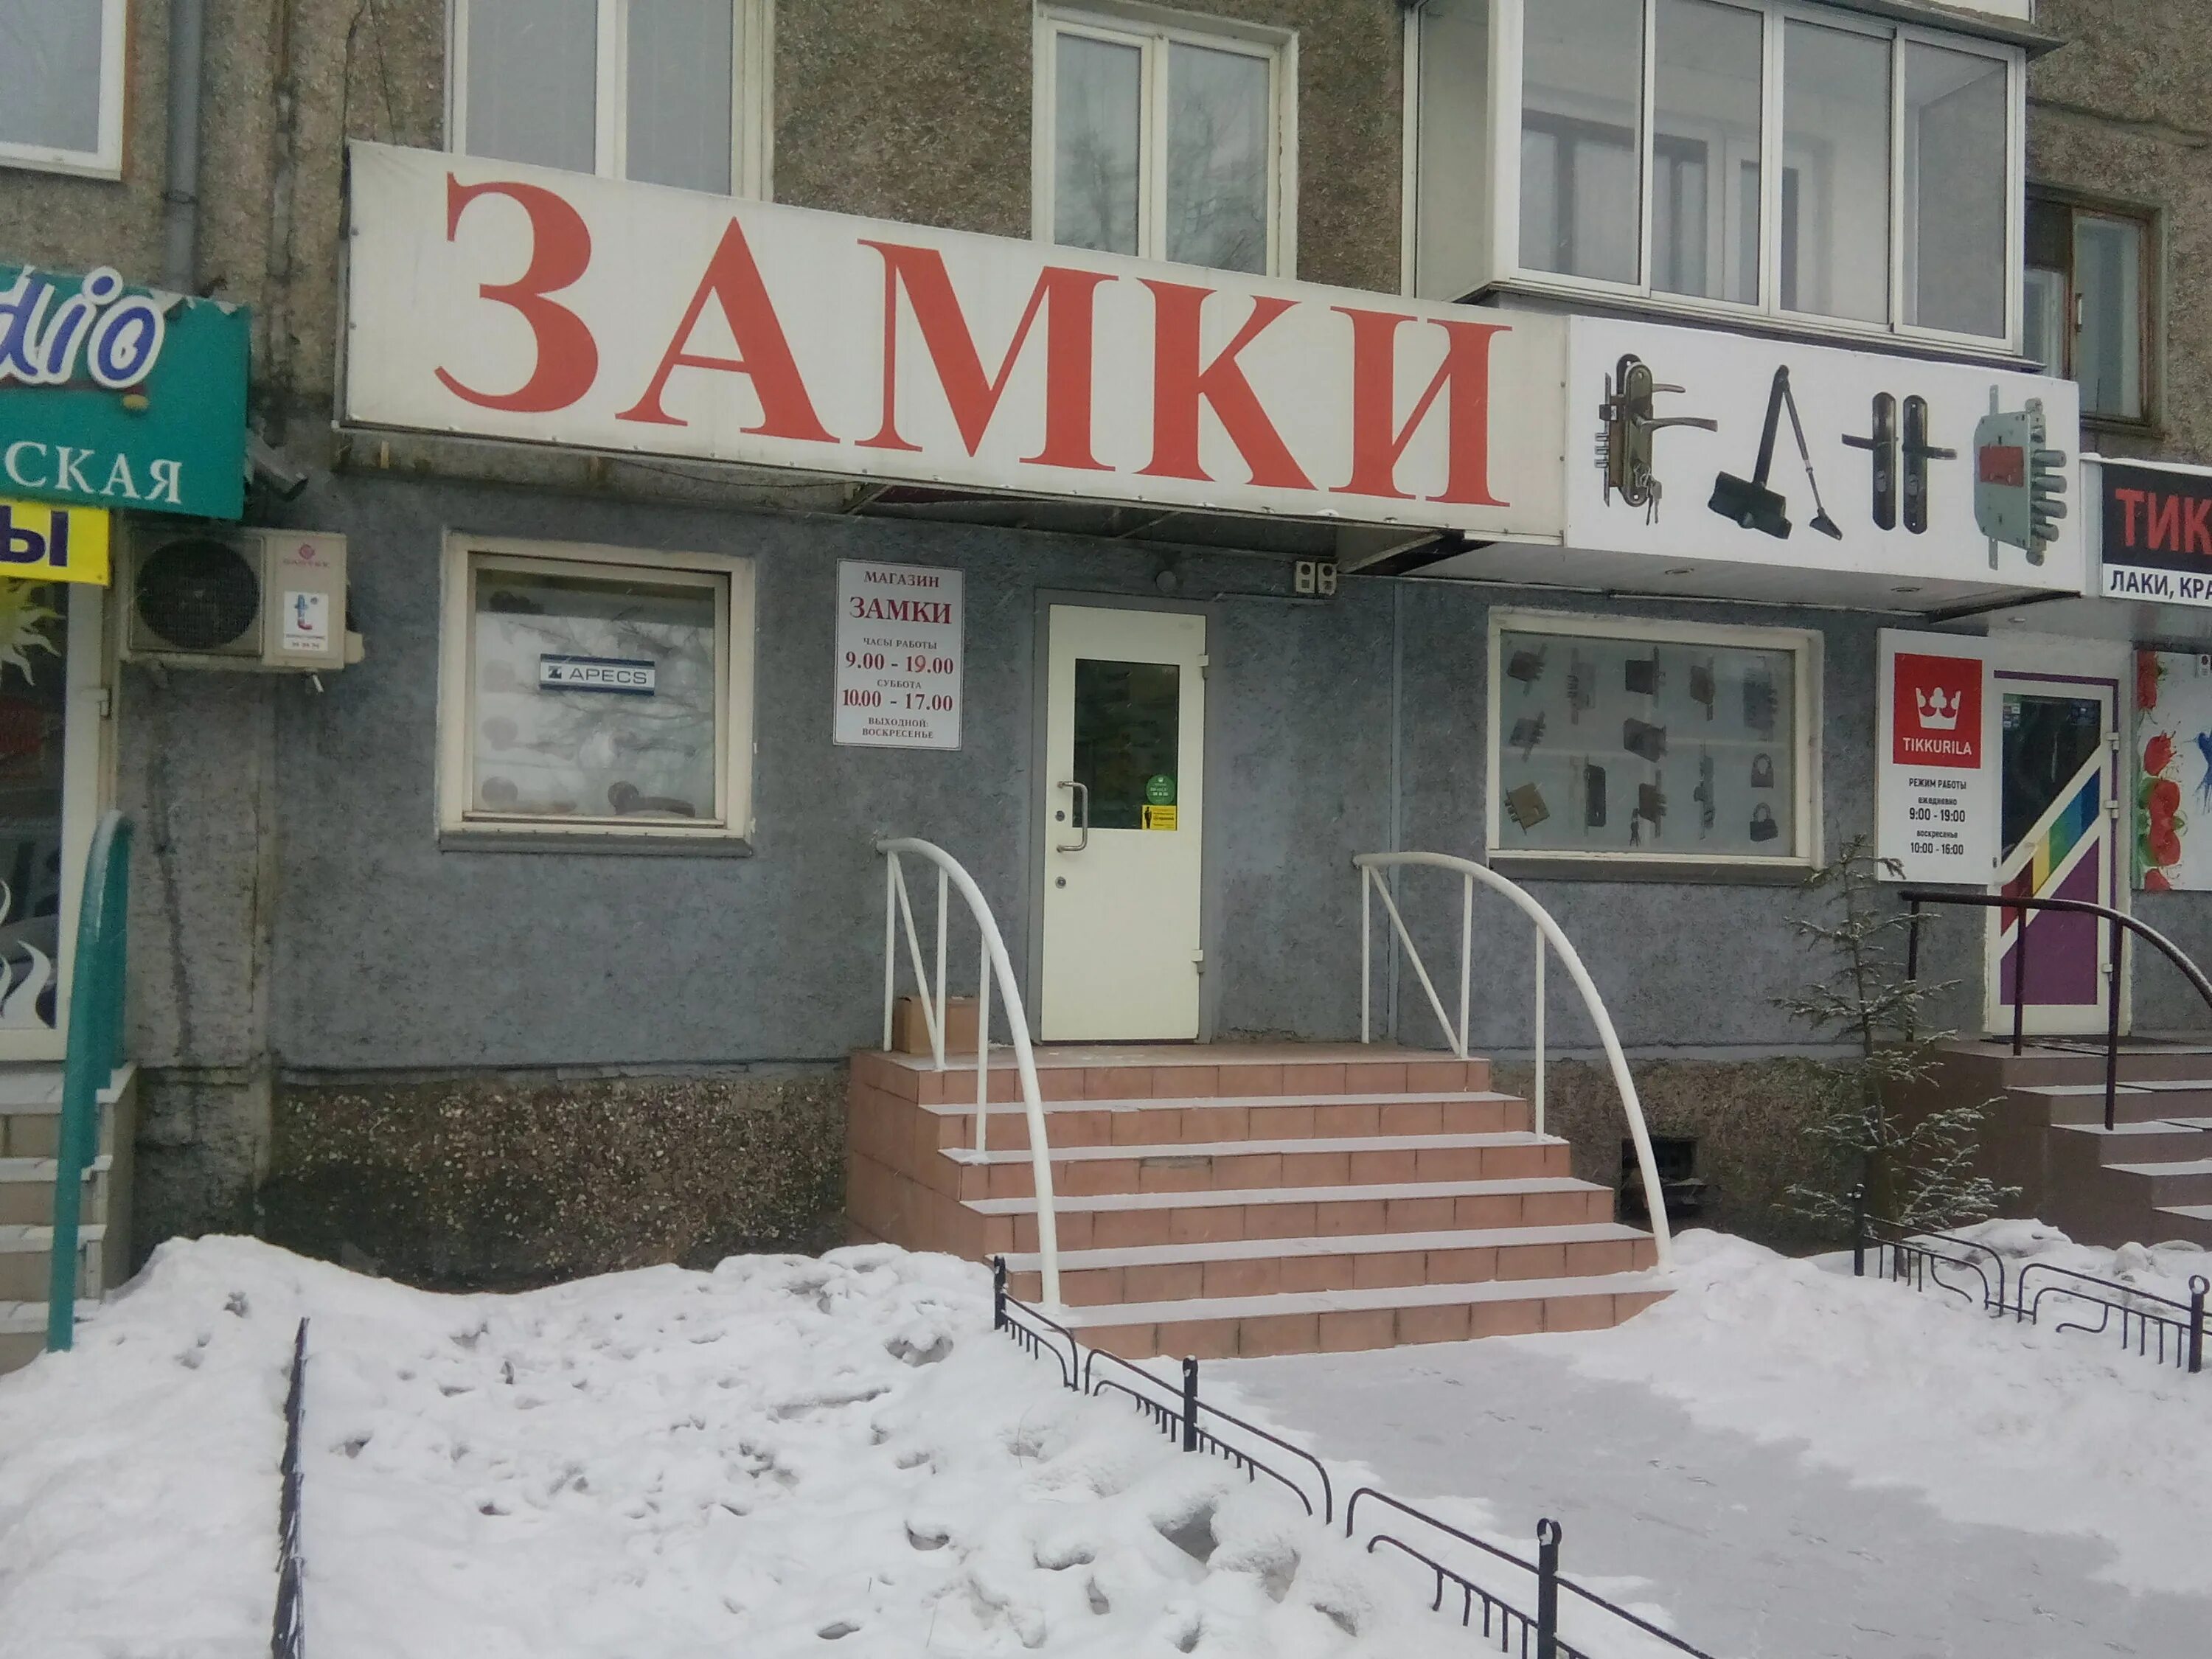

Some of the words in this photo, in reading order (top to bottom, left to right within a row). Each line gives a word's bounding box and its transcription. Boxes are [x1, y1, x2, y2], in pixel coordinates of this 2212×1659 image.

[434, 171, 1513, 509] ЗАМКИ
[4, 440, 183, 504] СКАЯ
[2115, 488, 2212, 555] ТИК
[864, 571, 939, 588] МАГАЗИН
[2110, 570, 2174, 599] ЛАКИ,
[849, 596, 952, 624] ЗАМКИ
[863, 637, 892, 647] ЧАСЫ
[896, 639, 937, 650] РАБОТЫ
[846, 651, 885, 670] 9.00
[905, 655, 954, 675] 19.00
[569, 667, 647, 685] APECS
[877, 679, 922, 689] СУББОТА
[843, 689, 882, 708] 10.00
[905, 692, 953, 712] 17.00
[862, 728, 933, 739] ВОСКРЕСЕНЬЕ
[1902, 737, 1972, 755] TIKKURILA
[1909, 778, 1936, 787] РЕЖИМ
[1938, 779, 1966, 790] РАБОТЫ
[1918, 796, 1958, 805] ежедневно
[1910, 807, 1930, 820] 9:00
[1941, 810, 1966, 822] 19:00
[1916, 830, 1958, 839] воскресенье
[1910, 842, 1933, 854] 10:00
[1941, 844, 1964, 855] 16:00
